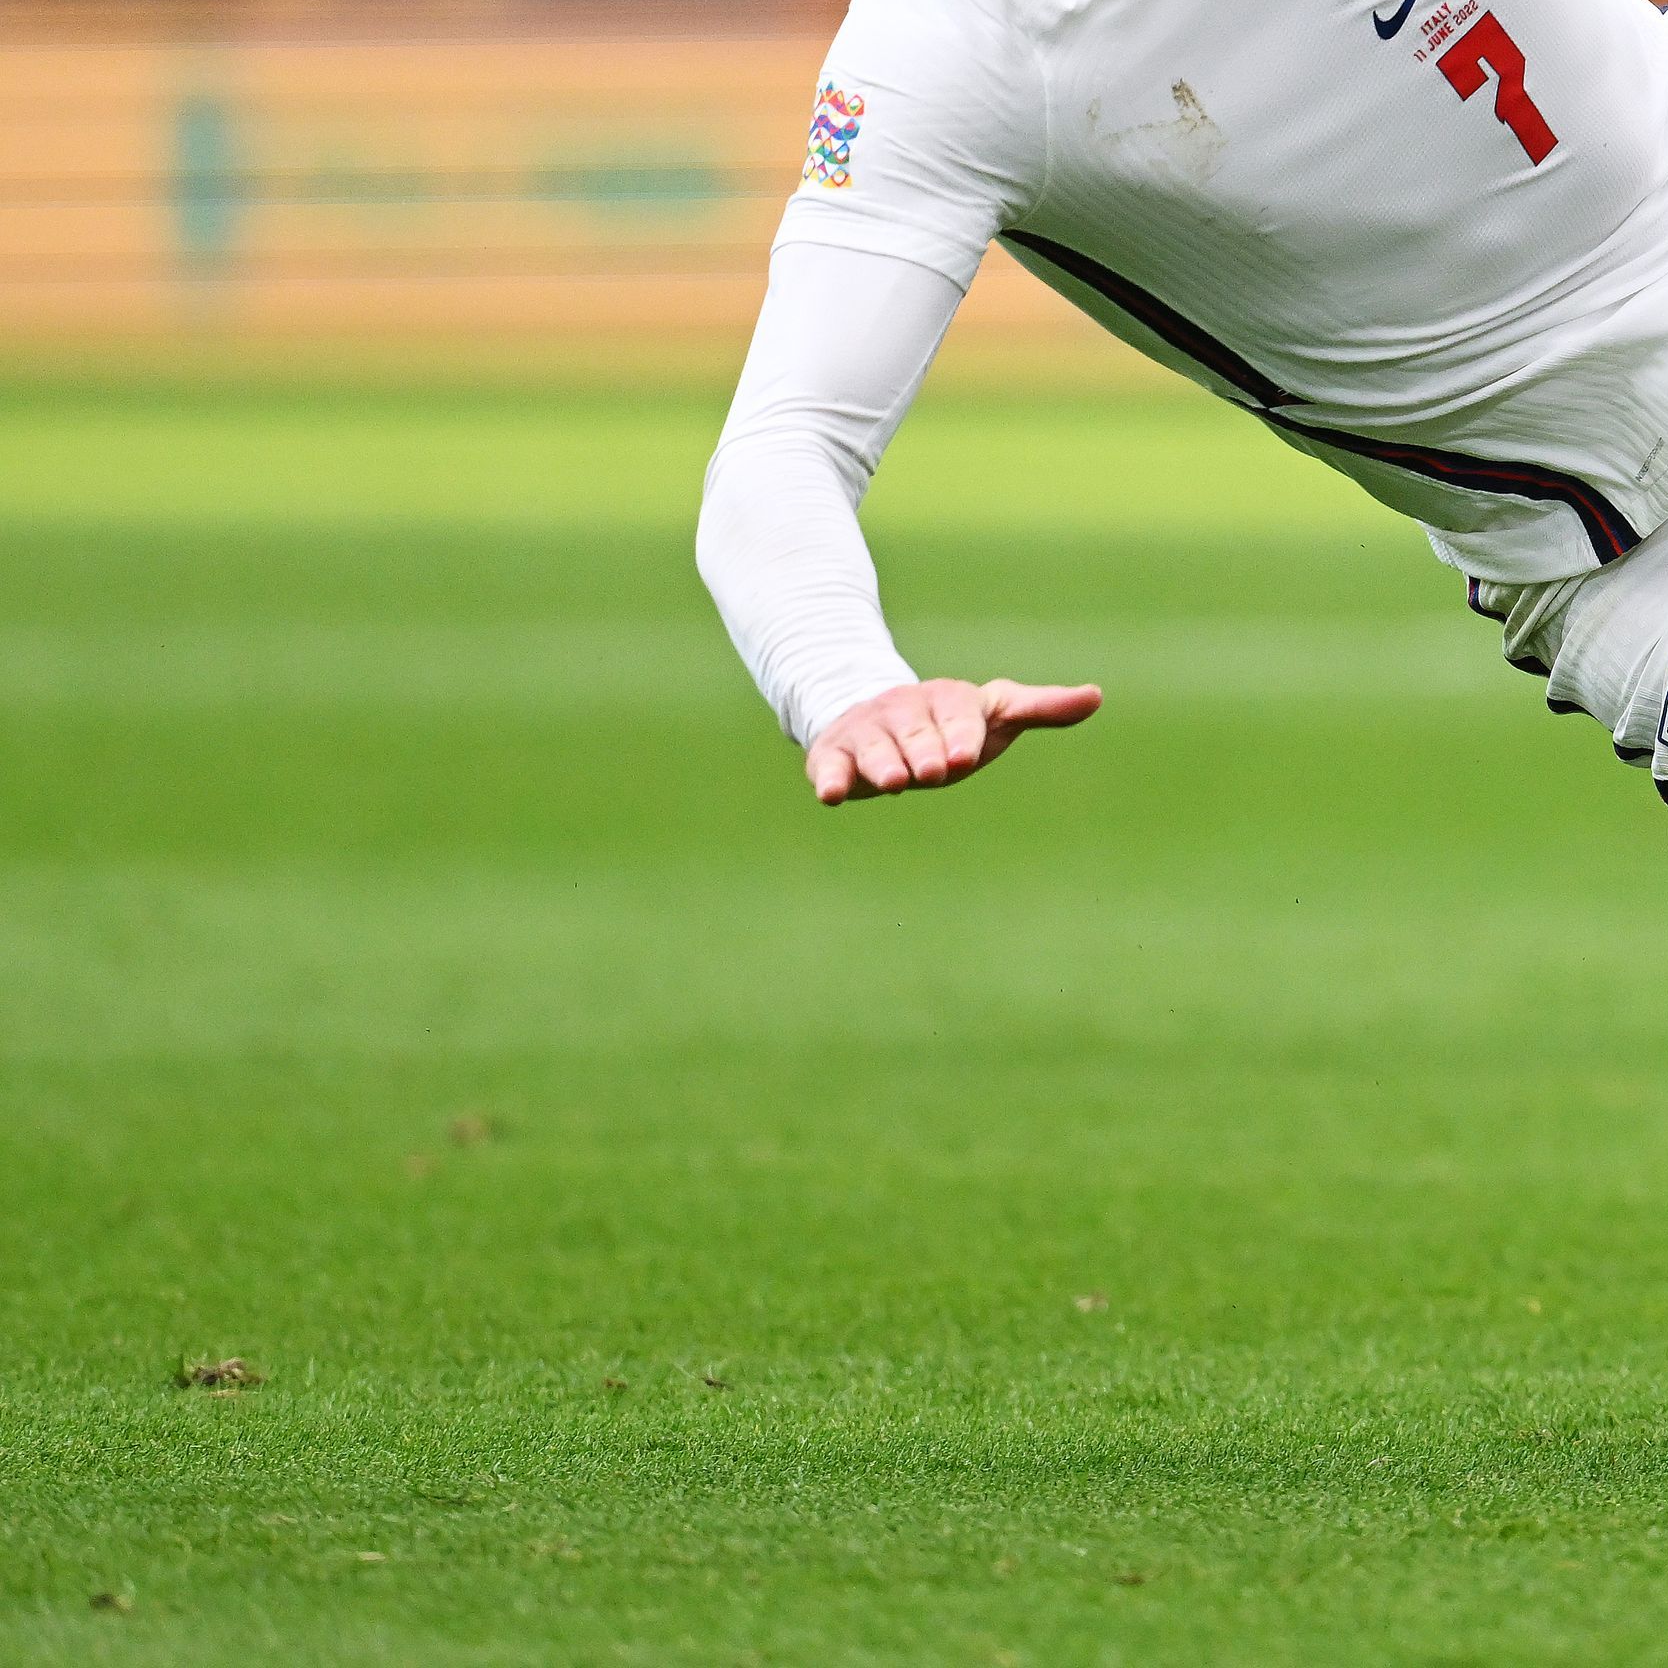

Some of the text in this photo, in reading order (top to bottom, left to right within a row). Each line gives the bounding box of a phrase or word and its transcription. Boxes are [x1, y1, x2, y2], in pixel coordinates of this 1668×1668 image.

[1413, 0, 1478, 63] 11 JUNE 2022
[1420, 2, 1451, 35] ITALY
[1436, 9, 1559, 166] 7
